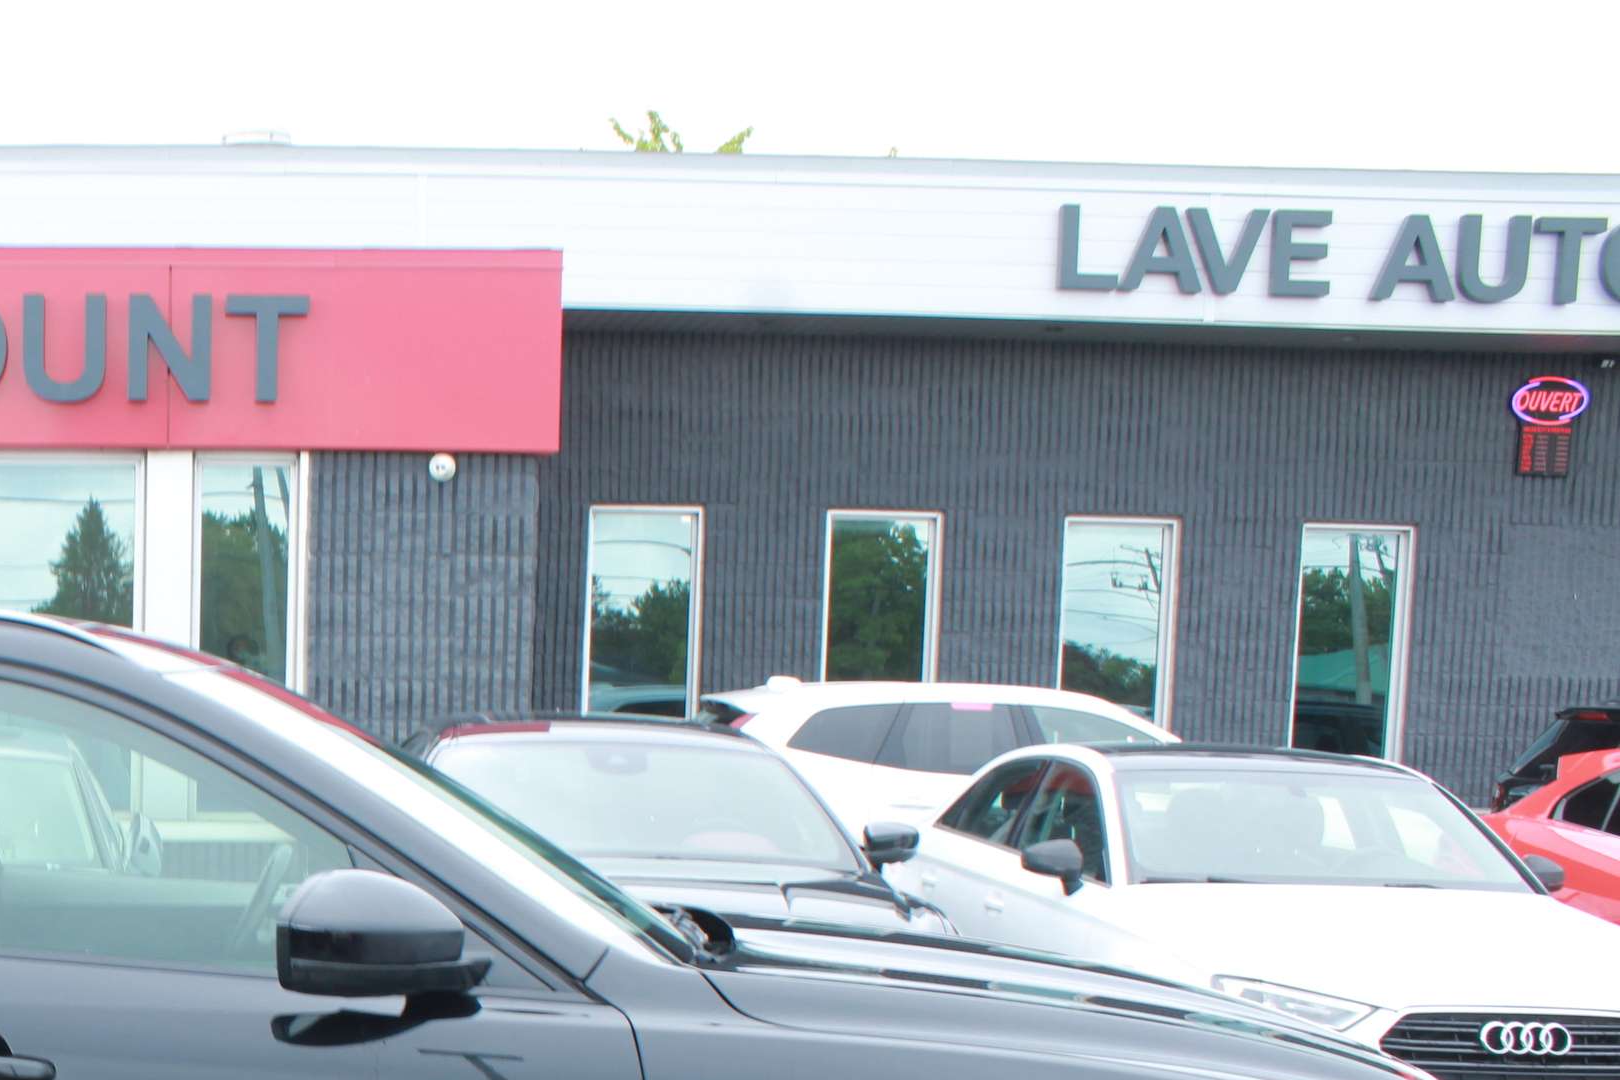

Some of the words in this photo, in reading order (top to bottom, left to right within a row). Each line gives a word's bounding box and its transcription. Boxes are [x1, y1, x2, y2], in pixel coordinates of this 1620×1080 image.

[1056, 203, 1333, 299] LAVE
[1368, 213, 1620, 306] AUT
[1518, 390, 1583, 412] OUVERT
